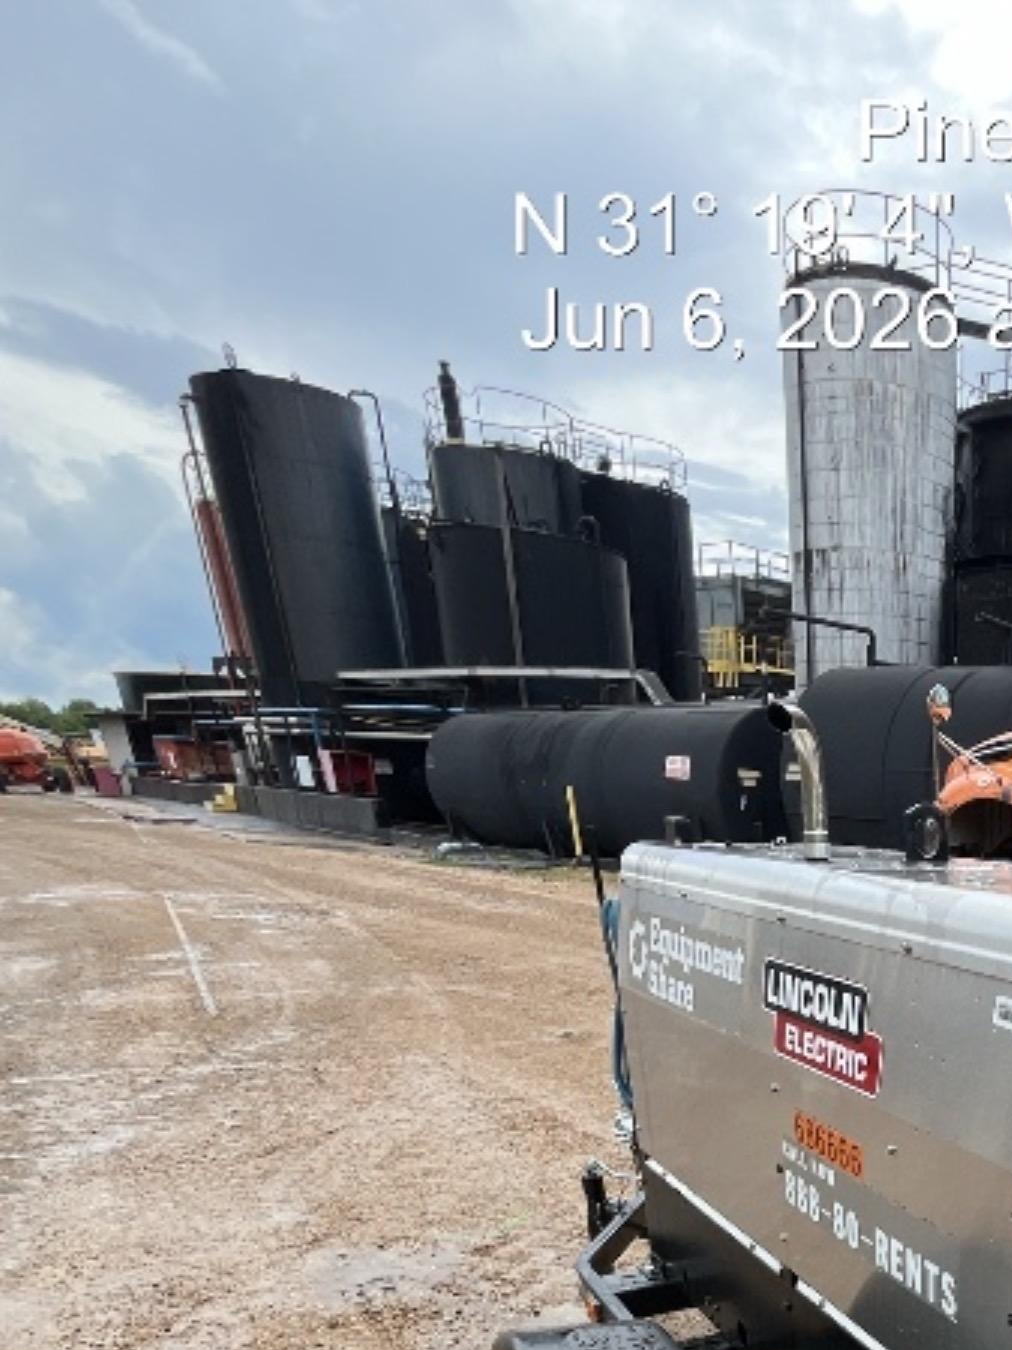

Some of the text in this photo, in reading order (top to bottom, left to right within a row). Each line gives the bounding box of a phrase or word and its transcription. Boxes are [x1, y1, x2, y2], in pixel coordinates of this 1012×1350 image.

[650, 917, 744, 984] Equipment
[648, 959, 694, 1012] Share
[767, 968, 862, 1035] LINCOLN
[785, 1022, 868, 1081] ELECTRIC
